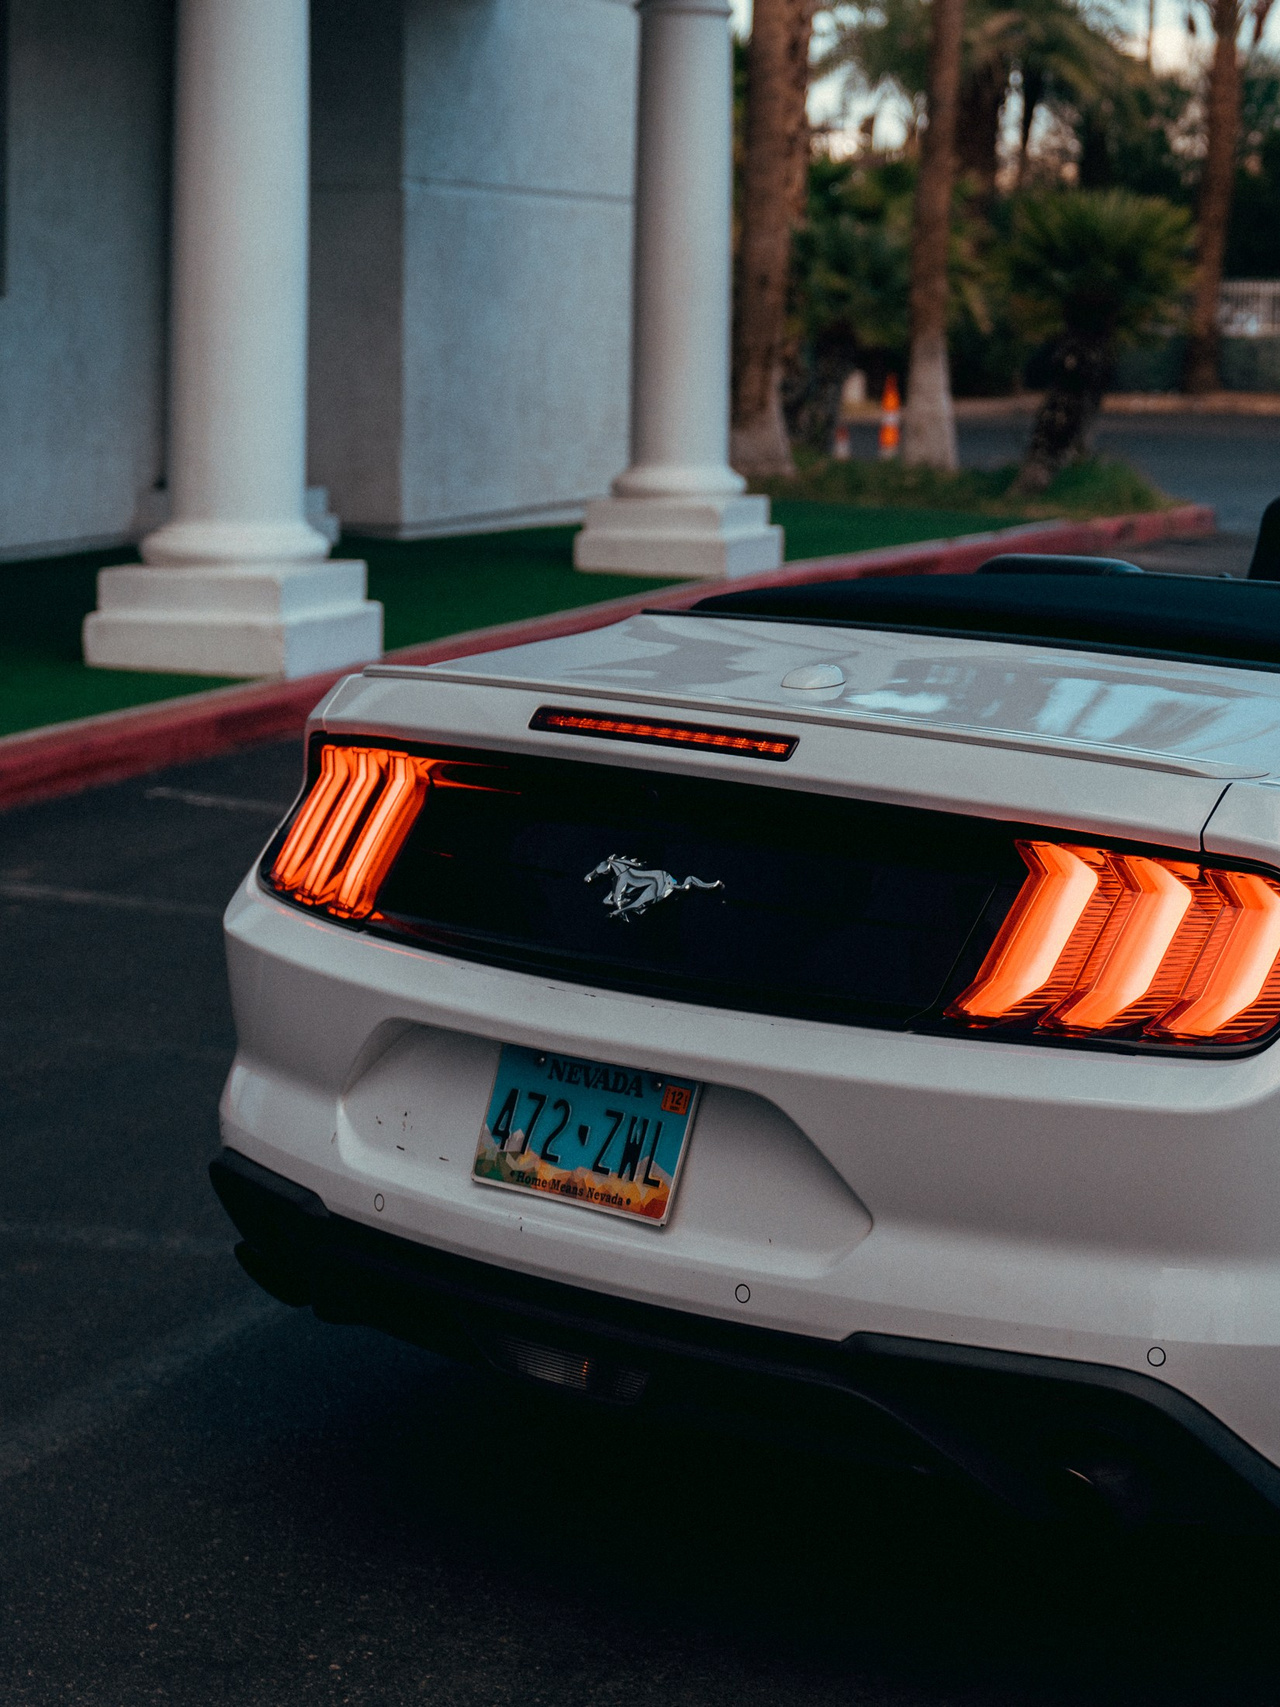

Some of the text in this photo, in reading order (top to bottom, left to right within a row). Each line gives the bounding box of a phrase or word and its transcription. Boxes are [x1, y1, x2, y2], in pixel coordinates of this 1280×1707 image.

[547, 1059, 643, 1097] NEVADA
[671, 1091, 684, 1106] 12
[516, 1171, 623, 1206] Home Means Nevada
